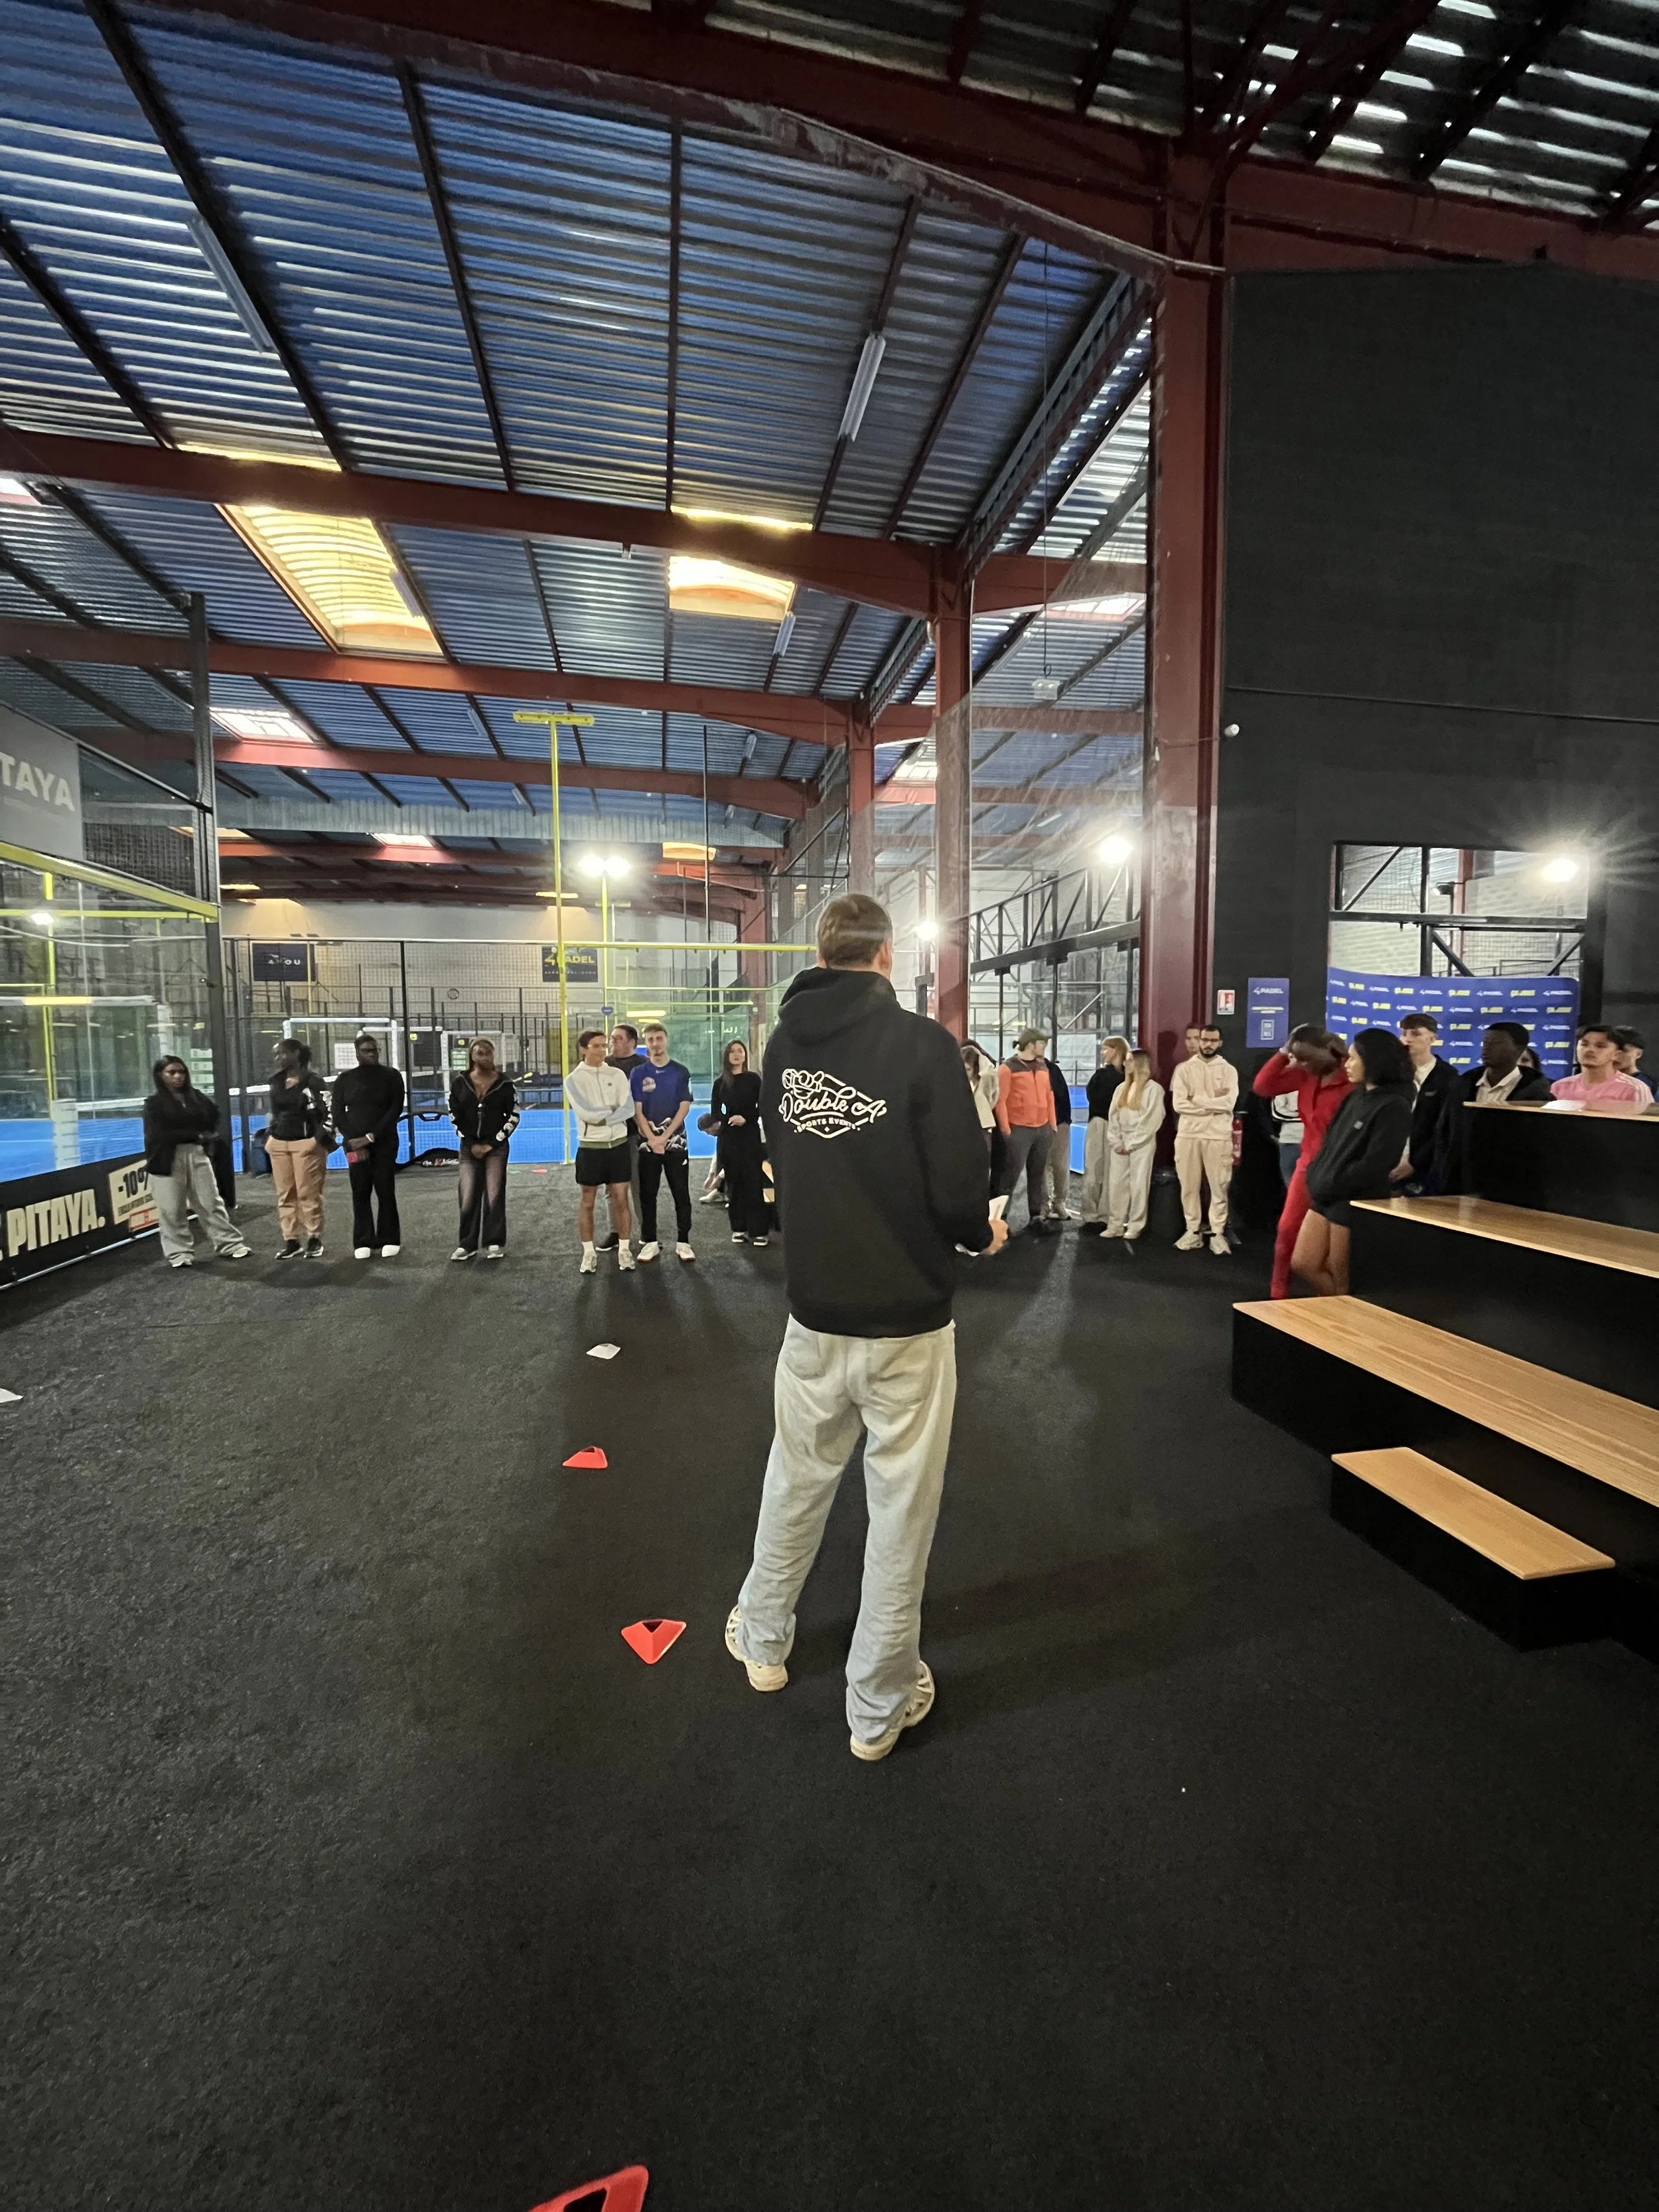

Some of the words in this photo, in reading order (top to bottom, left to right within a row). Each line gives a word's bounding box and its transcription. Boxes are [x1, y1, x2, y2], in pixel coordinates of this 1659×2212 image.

[0, 752, 75, 812] TAYA
[544, 954, 595, 966] 4ADEL
[778, 1087, 855, 1122] Double
[797, 1118, 827, 1132] SPORTS
[7, 1189, 106, 1257] PITAYA.
